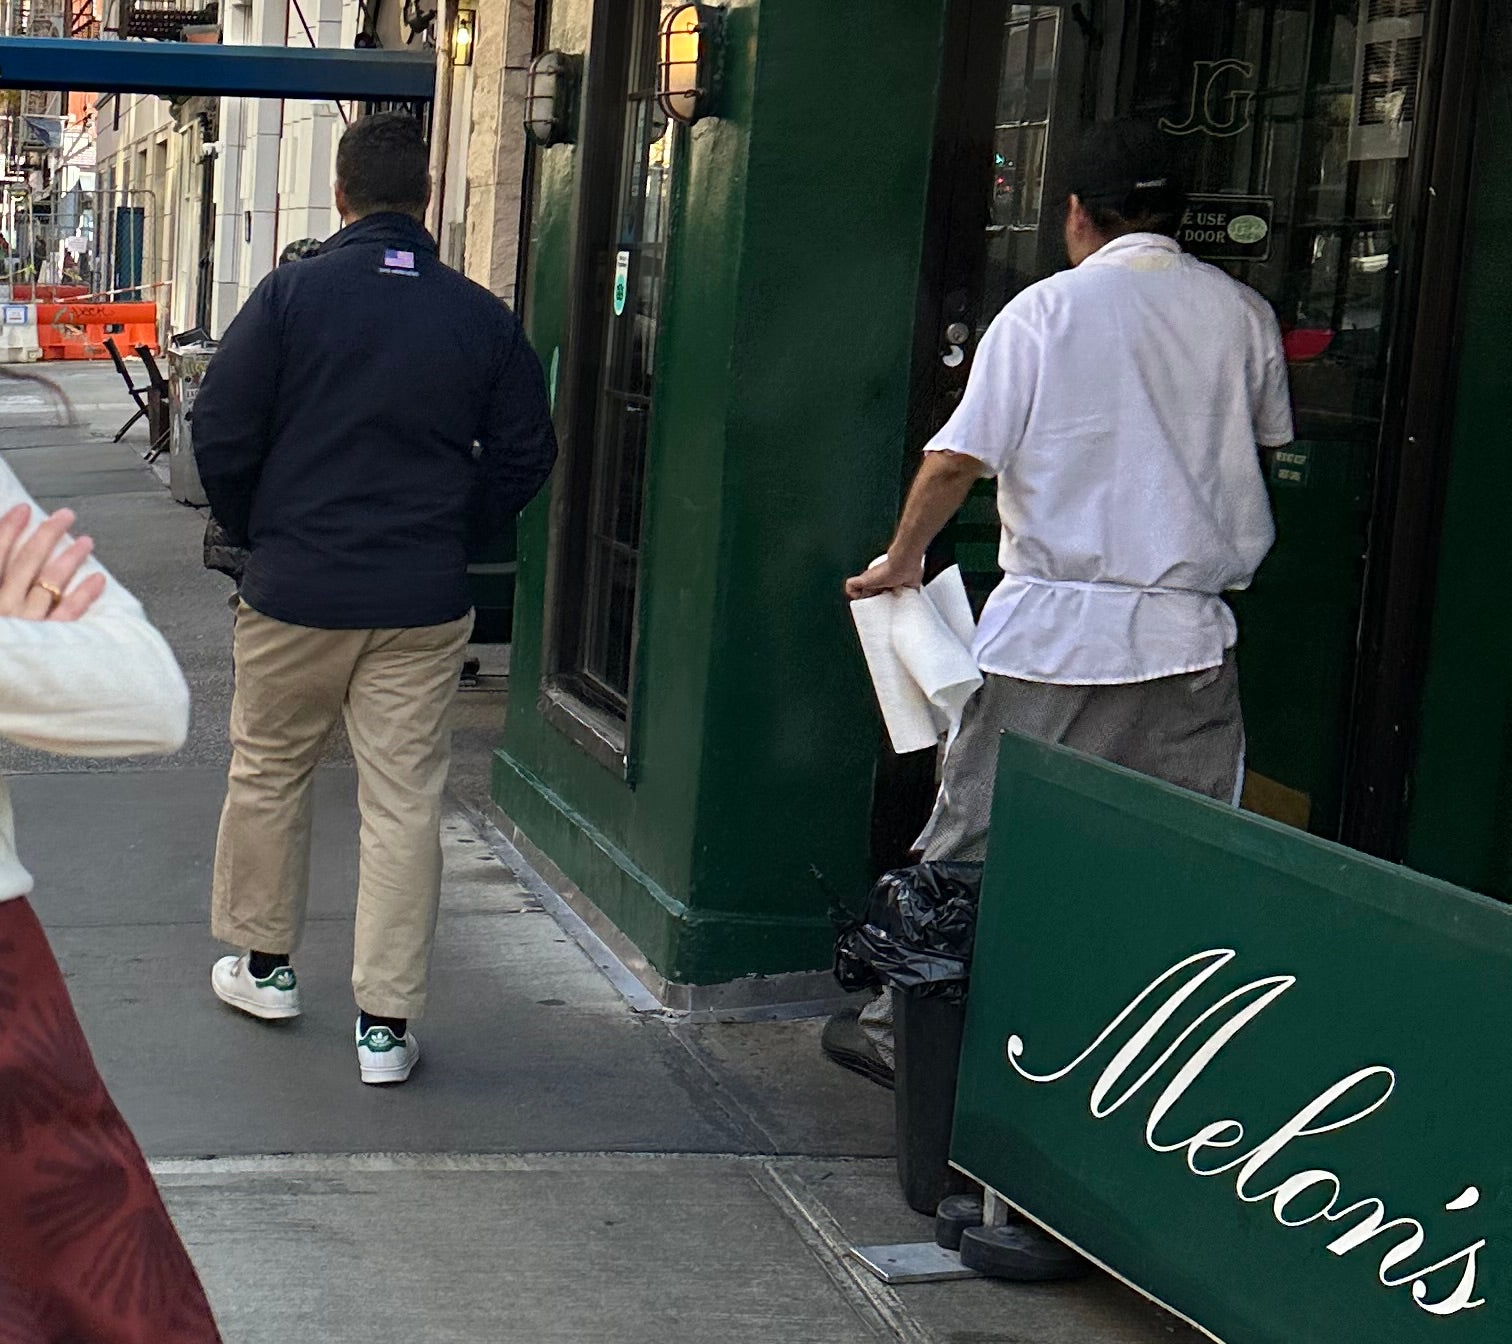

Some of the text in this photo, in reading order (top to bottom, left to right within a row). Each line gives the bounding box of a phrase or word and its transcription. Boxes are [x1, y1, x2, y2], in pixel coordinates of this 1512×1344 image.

[1196, 213, 1227, 226] USE
[1184, 229, 1226, 244] DOOR
[1007, 947, 1486, 1316] Melon's
